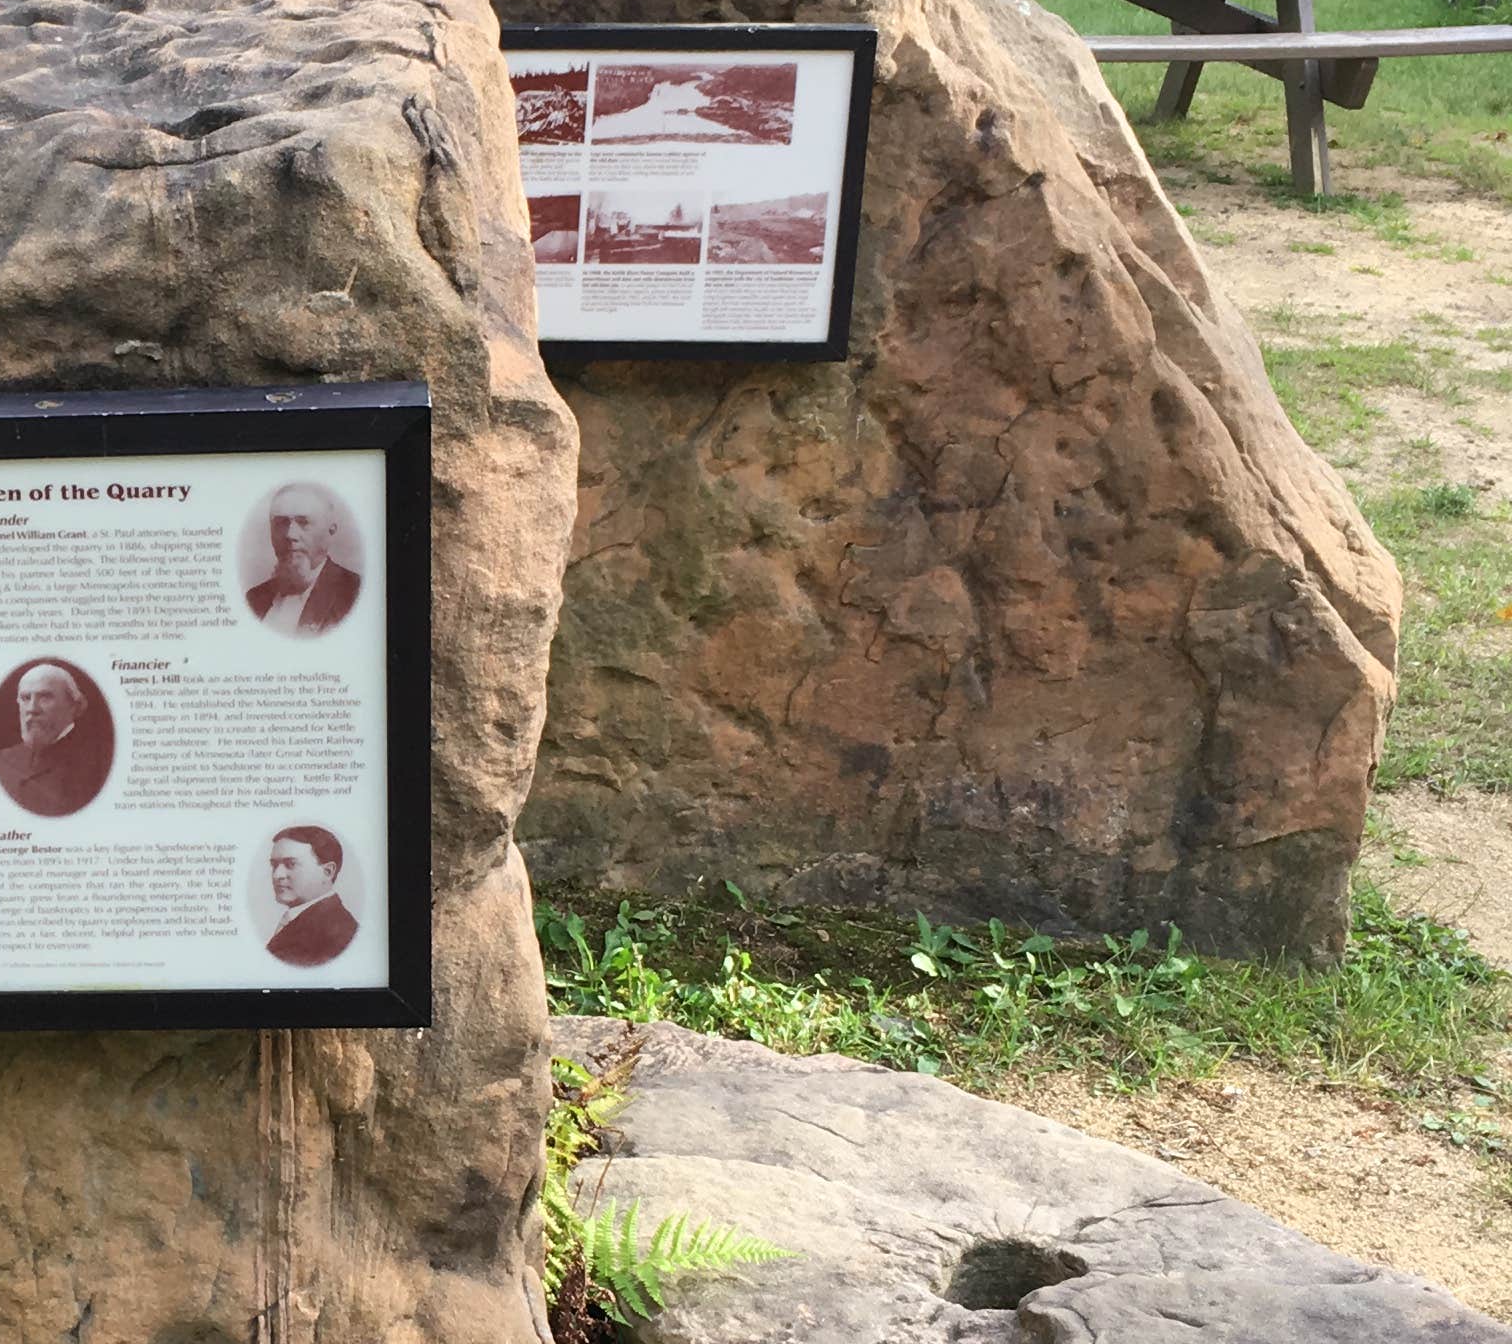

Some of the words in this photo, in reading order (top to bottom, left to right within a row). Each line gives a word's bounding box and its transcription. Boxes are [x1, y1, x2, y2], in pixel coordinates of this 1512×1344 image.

[29, 482, 51, 500] of
[61, 481, 99, 500] the
[107, 480, 190, 504] Quarry
[111, 659, 169, 670] Financier
